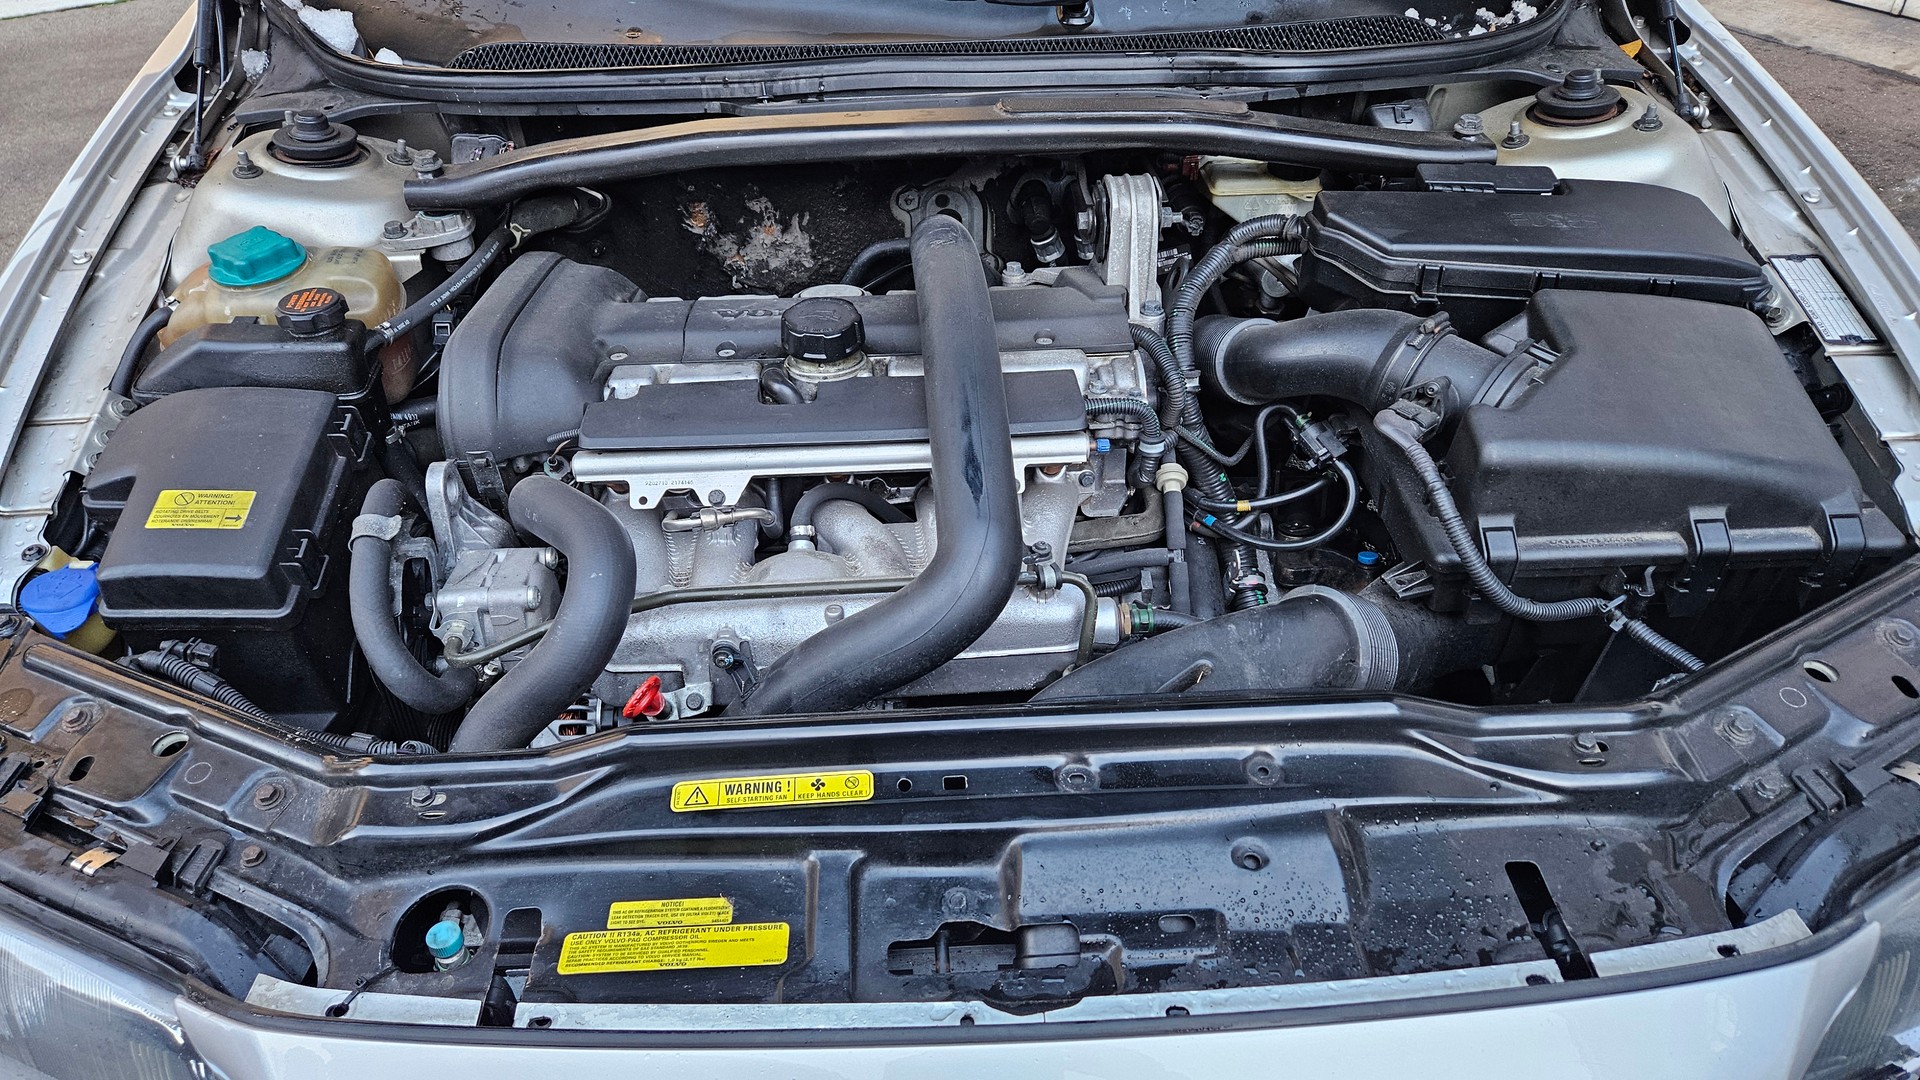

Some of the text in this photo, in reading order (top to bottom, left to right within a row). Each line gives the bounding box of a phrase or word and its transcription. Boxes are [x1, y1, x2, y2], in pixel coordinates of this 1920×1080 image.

[724, 780, 791, 796] WARNING !
[726, 795, 774, 804] SELF-STARTING
[658, 927, 712, 935] REFRIGERANT
